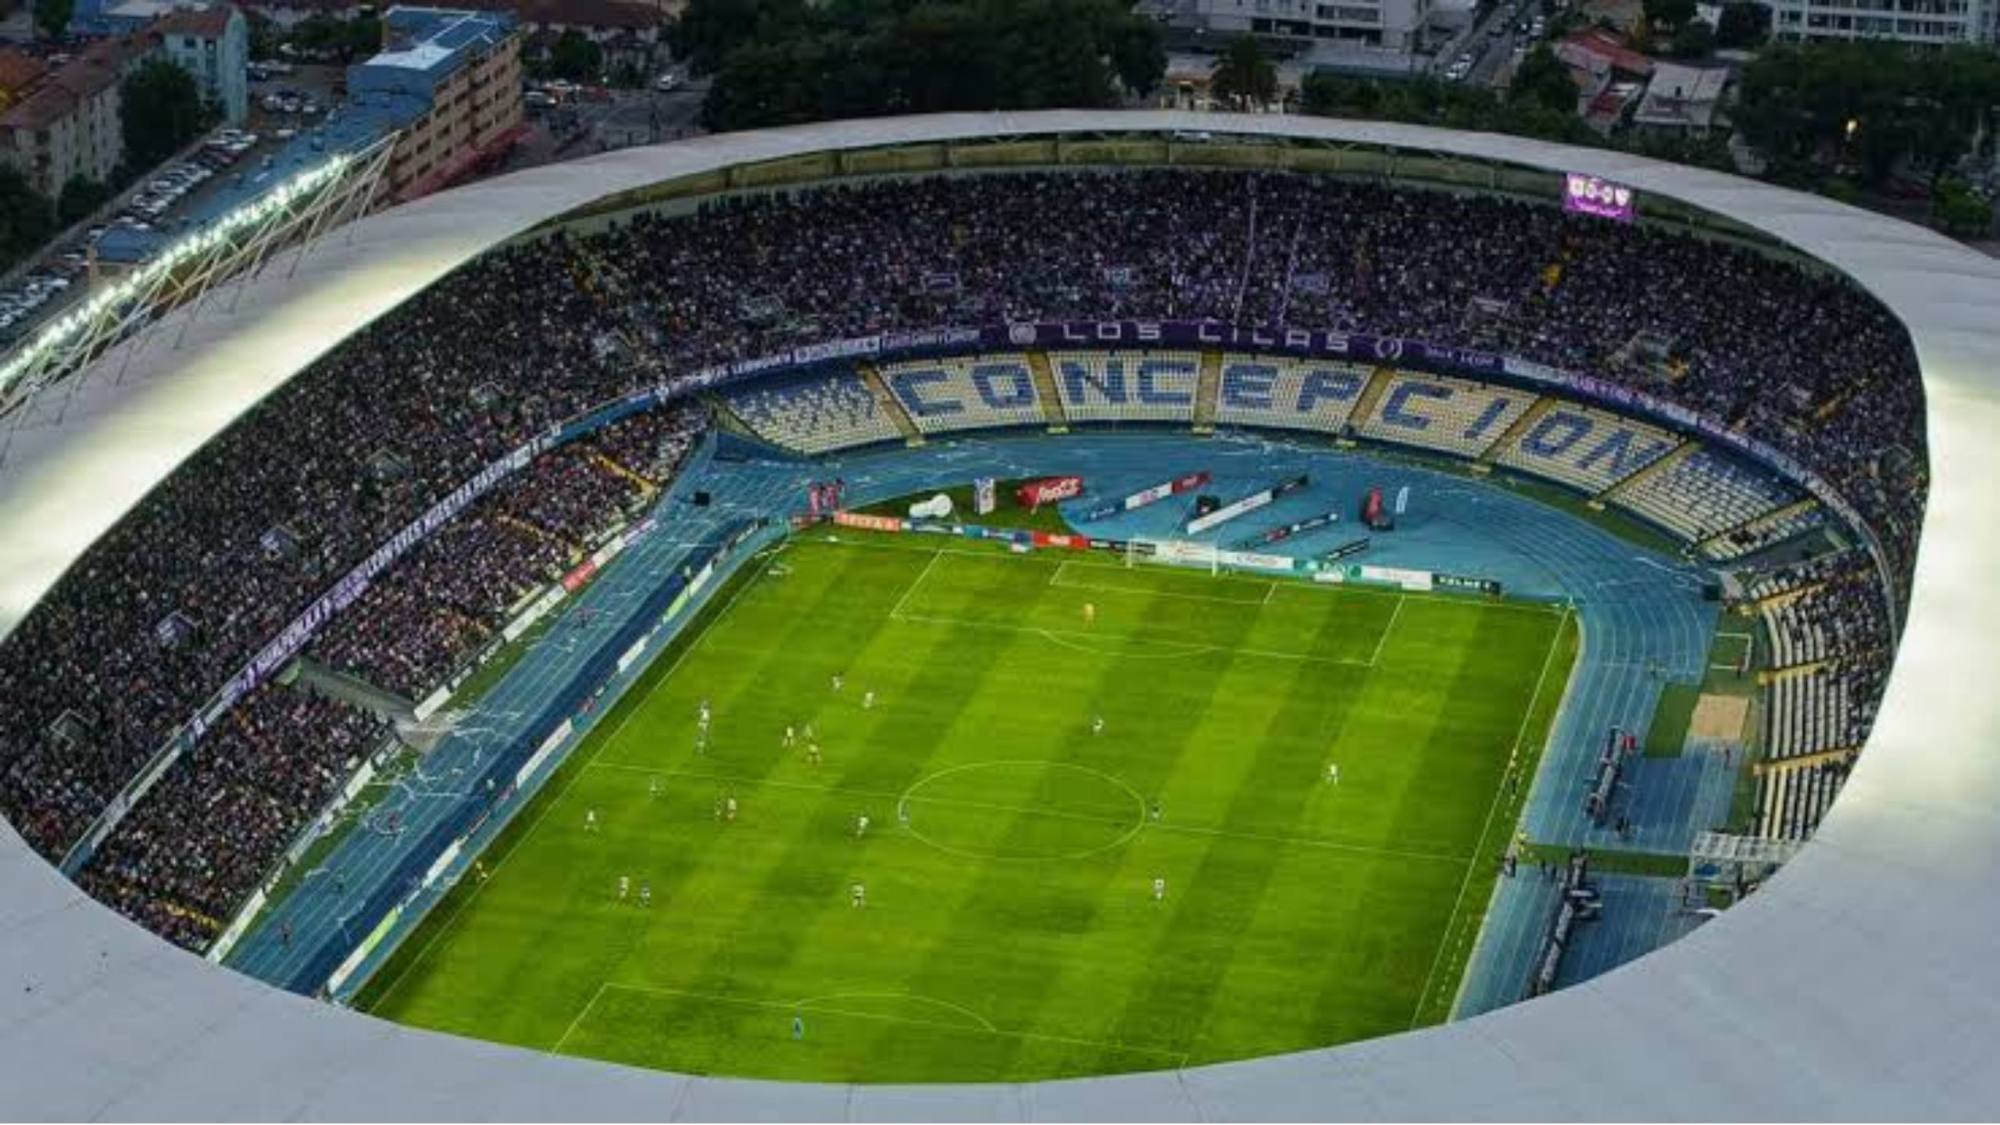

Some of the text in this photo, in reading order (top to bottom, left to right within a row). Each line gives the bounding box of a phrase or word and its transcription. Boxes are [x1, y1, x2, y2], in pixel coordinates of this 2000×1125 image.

[1063, 324, 1349, 351] LOS LILAS
[891, 360, 1670, 475] CONCEPCION
